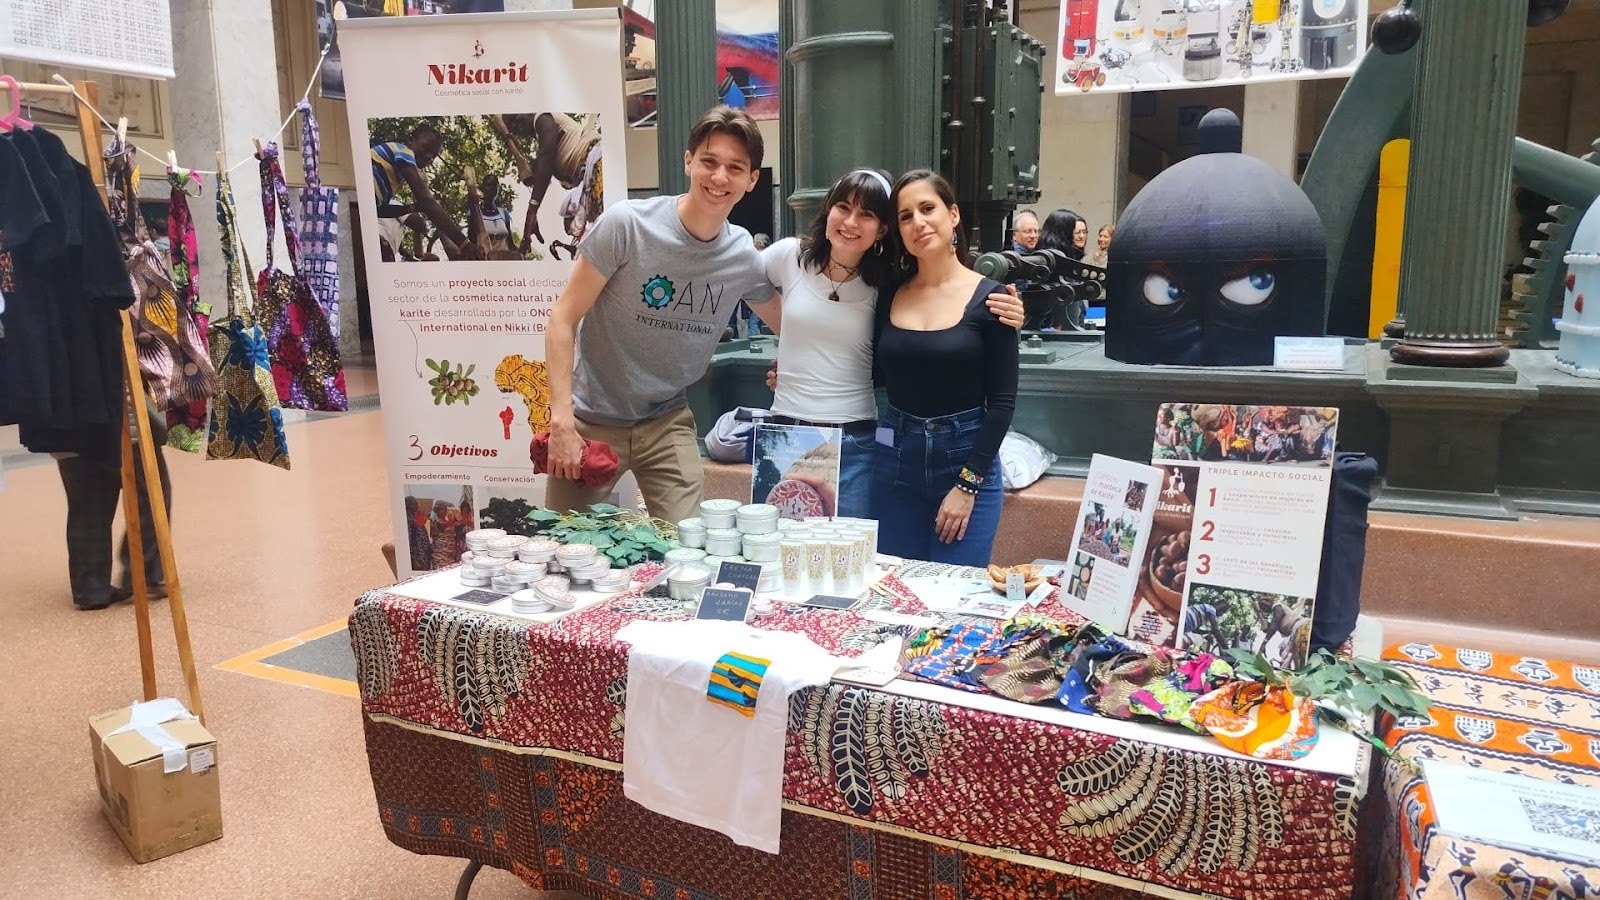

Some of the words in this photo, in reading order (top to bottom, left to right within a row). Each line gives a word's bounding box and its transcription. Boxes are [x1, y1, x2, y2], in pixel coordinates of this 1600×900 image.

[427, 61, 529, 85] Nikarit
[472, 88, 491, 96] social
[393, 279, 429, 289] Somos
[431, 280, 446, 288] un
[449, 279, 494, 290] proyecto
[497, 278, 527, 288] social
[388, 295, 420, 303] sector
[422, 294, 437, 303] de
[440, 294, 449, 303] la
[452, 292, 504, 302] cosmética
[507, 293, 543, 302] natural
[546, 294, 553, 302] a
[400, 308, 431, 318] karité
[433, 308, 496, 318] desarrollada
[499, 309, 515, 320] por
[517, 308, 527, 318] la
[420, 323, 488, 332] International
[490, 324, 502, 332] en
[505, 323, 530, 333] Nikki
[634, 314, 714, 334] INTERNATIONAL
[408, 434, 423, 461] 3
[430, 444, 498, 458] Objetivos
[404, 472, 471, 481] Empoderamiento
[1208, 467, 1239, 476] TRIPLE
[1242, 469, 1285, 479] IMPACTO
[1288, 472, 1325, 482] SOCIAL
[1208, 487, 1217, 508] 1
[1156, 502, 1192, 514] ikarit
[1199, 520, 1215, 542] 2
[1195, 554, 1211, 575] 3
